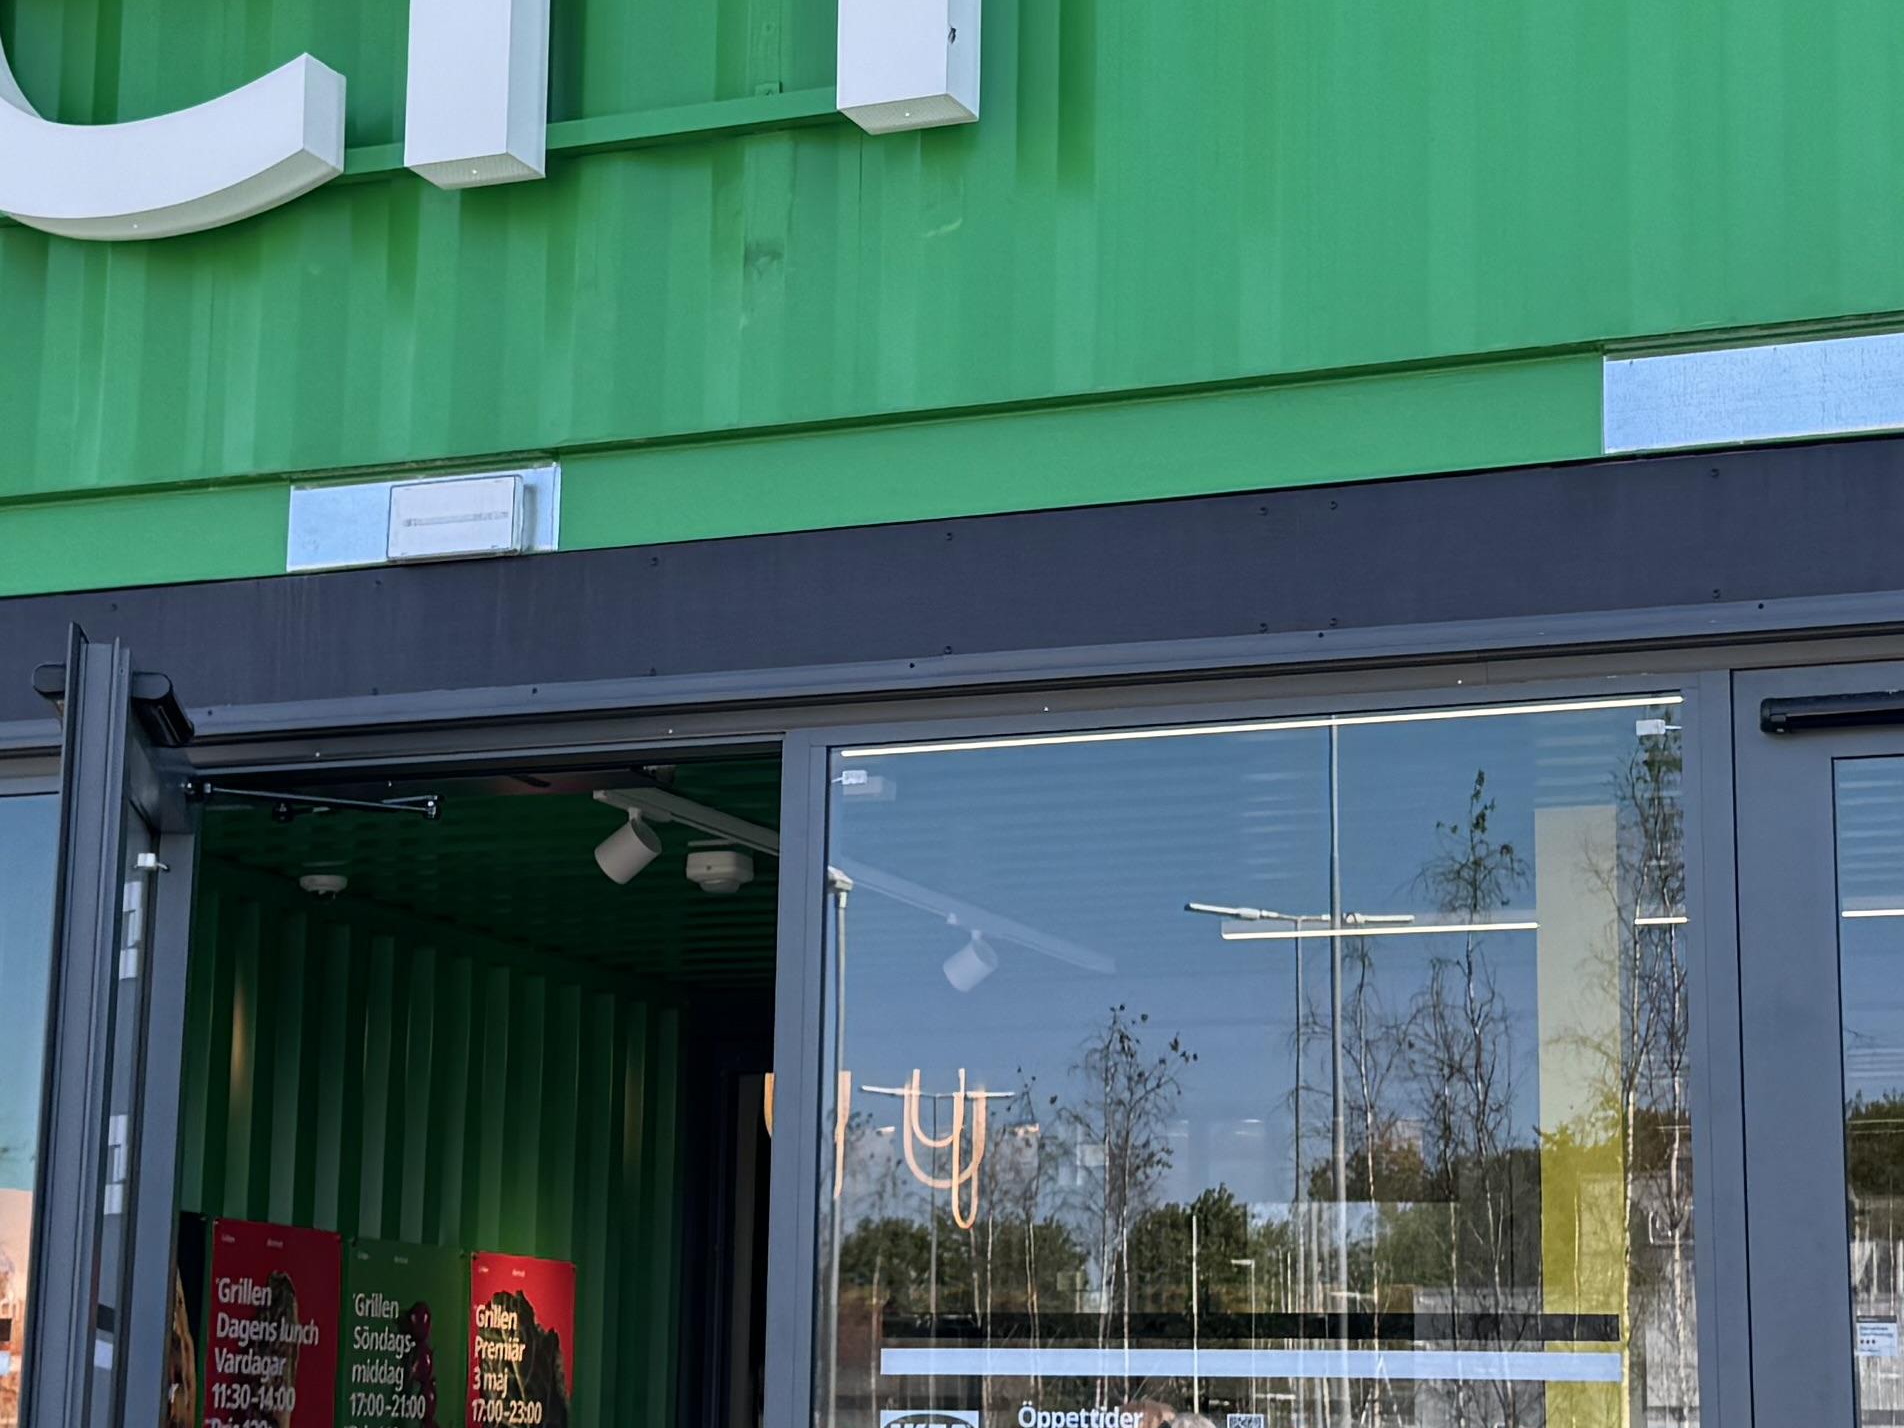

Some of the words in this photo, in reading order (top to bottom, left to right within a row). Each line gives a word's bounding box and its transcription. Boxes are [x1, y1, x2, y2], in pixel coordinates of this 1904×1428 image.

[216, 1312, 277, 1347] Dagens
[279, 1316, 319, 1346] lunch
[353, 1326, 416, 1359] Söndags-
[214, 1347, 287, 1383] Vardagar
[474, 1335, 526, 1362] Premiär
[352, 1359, 404, 1392] middag
[472, 1366, 481, 1390] 3
[483, 1367, 508, 1399] maj
